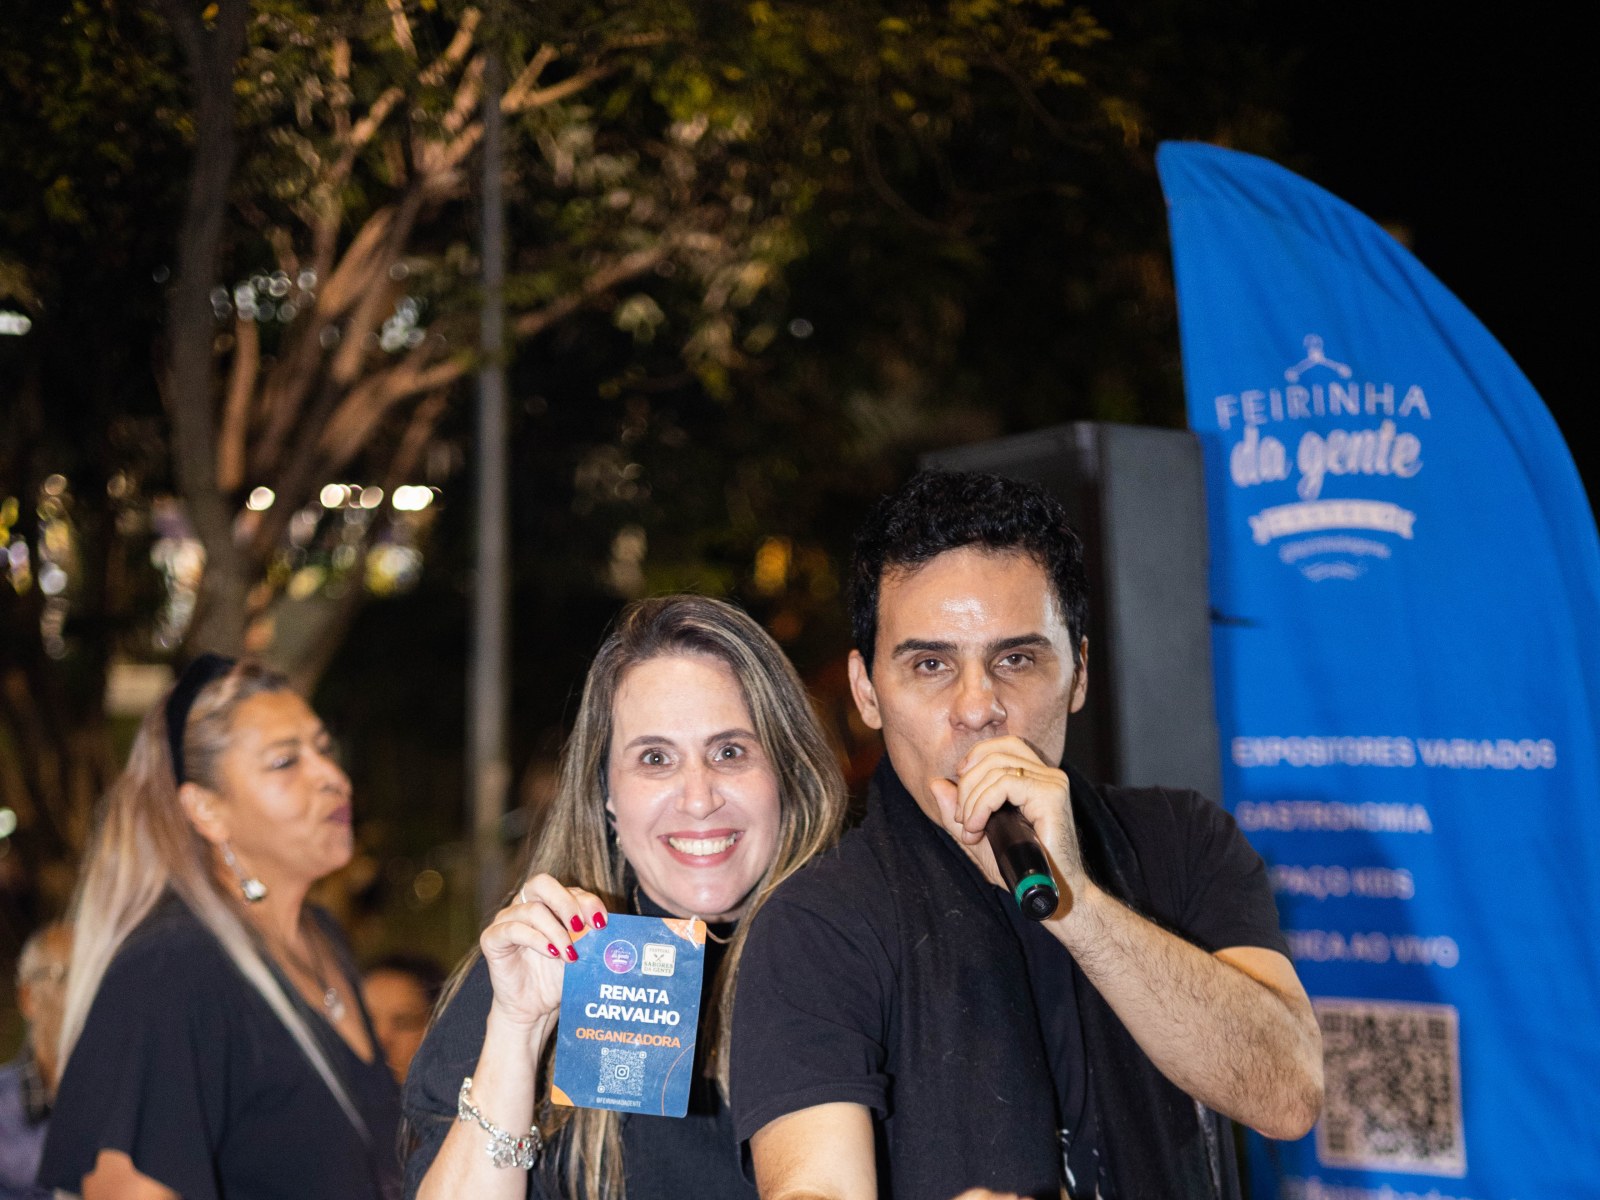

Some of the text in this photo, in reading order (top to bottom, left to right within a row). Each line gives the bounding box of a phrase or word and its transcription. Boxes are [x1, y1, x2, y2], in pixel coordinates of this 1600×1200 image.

[1214, 381, 1431, 430] FEIRINHA
[1230, 419, 1424, 500] da gente
[1232, 735, 1557, 770] EXPOSITORES VARIADOS
[599, 984, 670, 1005] RENATA
[585, 1002, 680, 1026] CARVALHO
[575, 1027, 681, 1048] ORGANIZADORA
